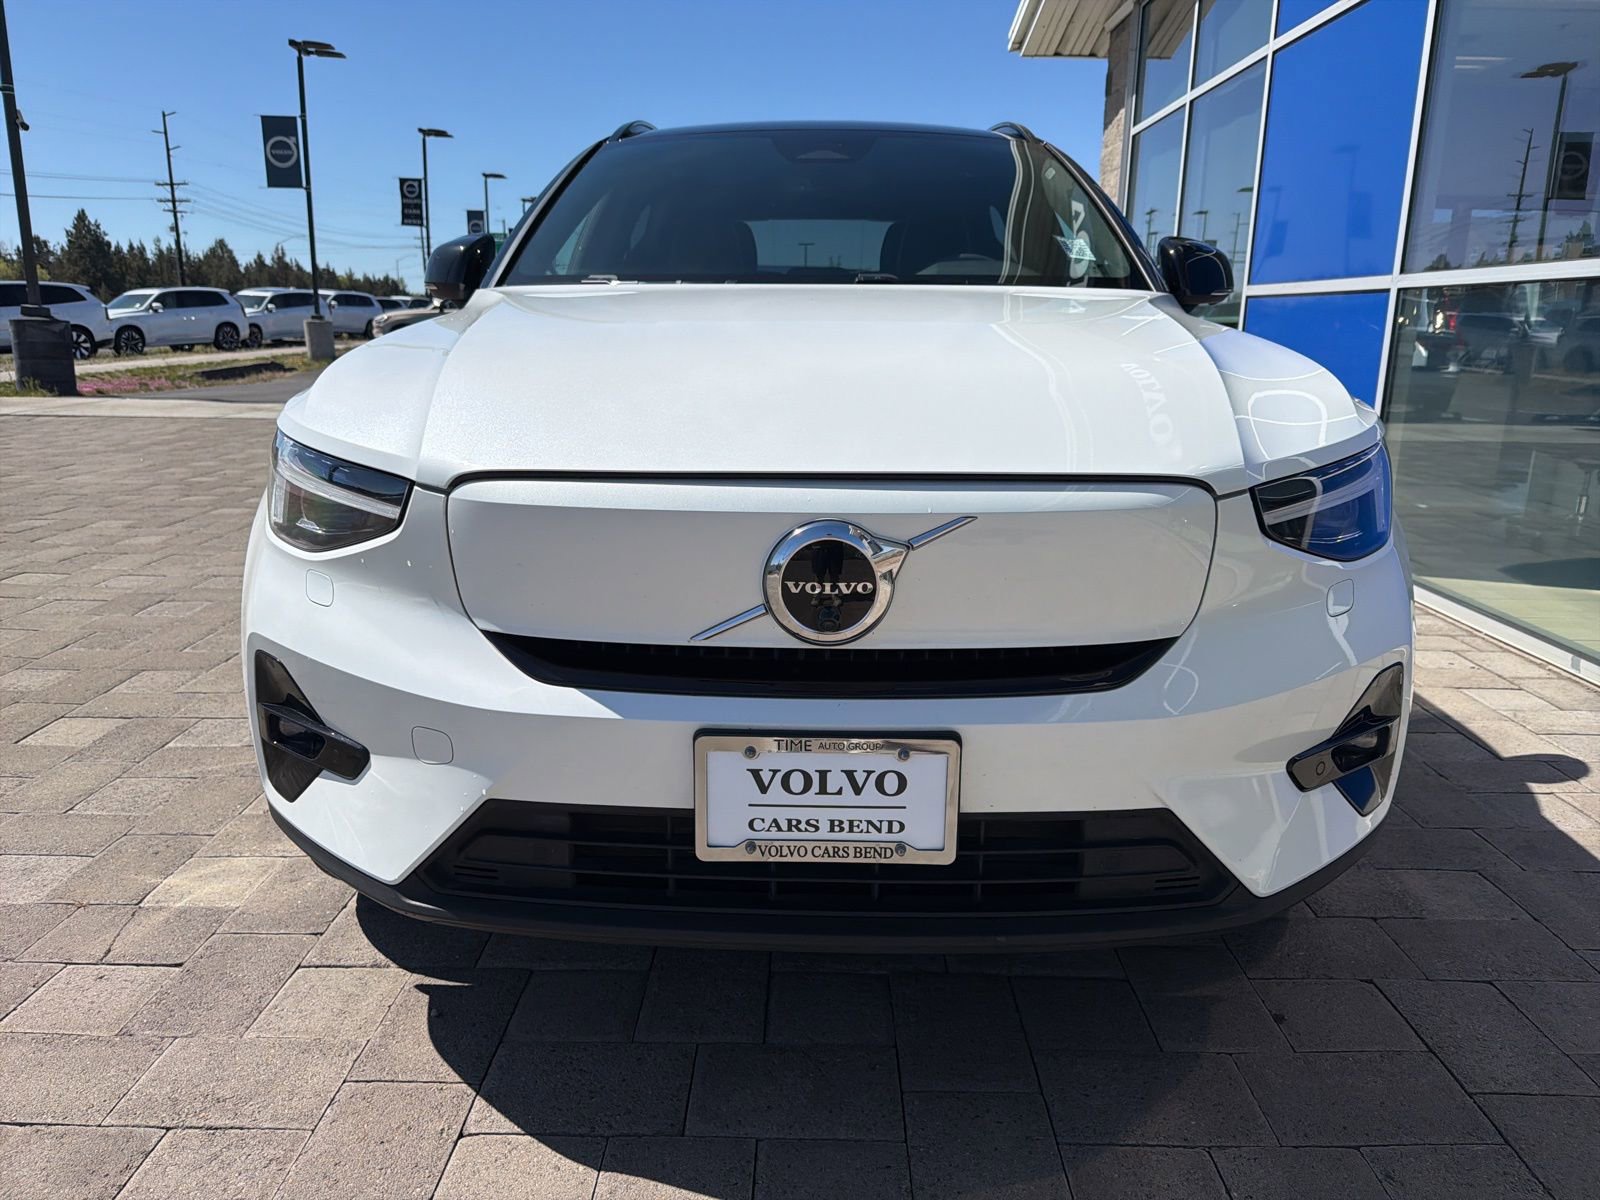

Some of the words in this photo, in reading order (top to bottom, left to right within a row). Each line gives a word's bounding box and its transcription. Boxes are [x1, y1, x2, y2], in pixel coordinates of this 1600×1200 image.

[784, 581, 873, 594] VOLVO
[774, 739, 812, 752] TIME
[818, 741, 846, 751] AUTO
[847, 742, 882, 752] GROUP
[746, 768, 908, 797] VOLVO
[747, 817, 820, 833] CARS
[827, 818, 906, 834] BEND
[757, 844, 808, 858] VOLVO
[811, 846, 850, 859] CARS
[853, 846, 894, 860] BEND
